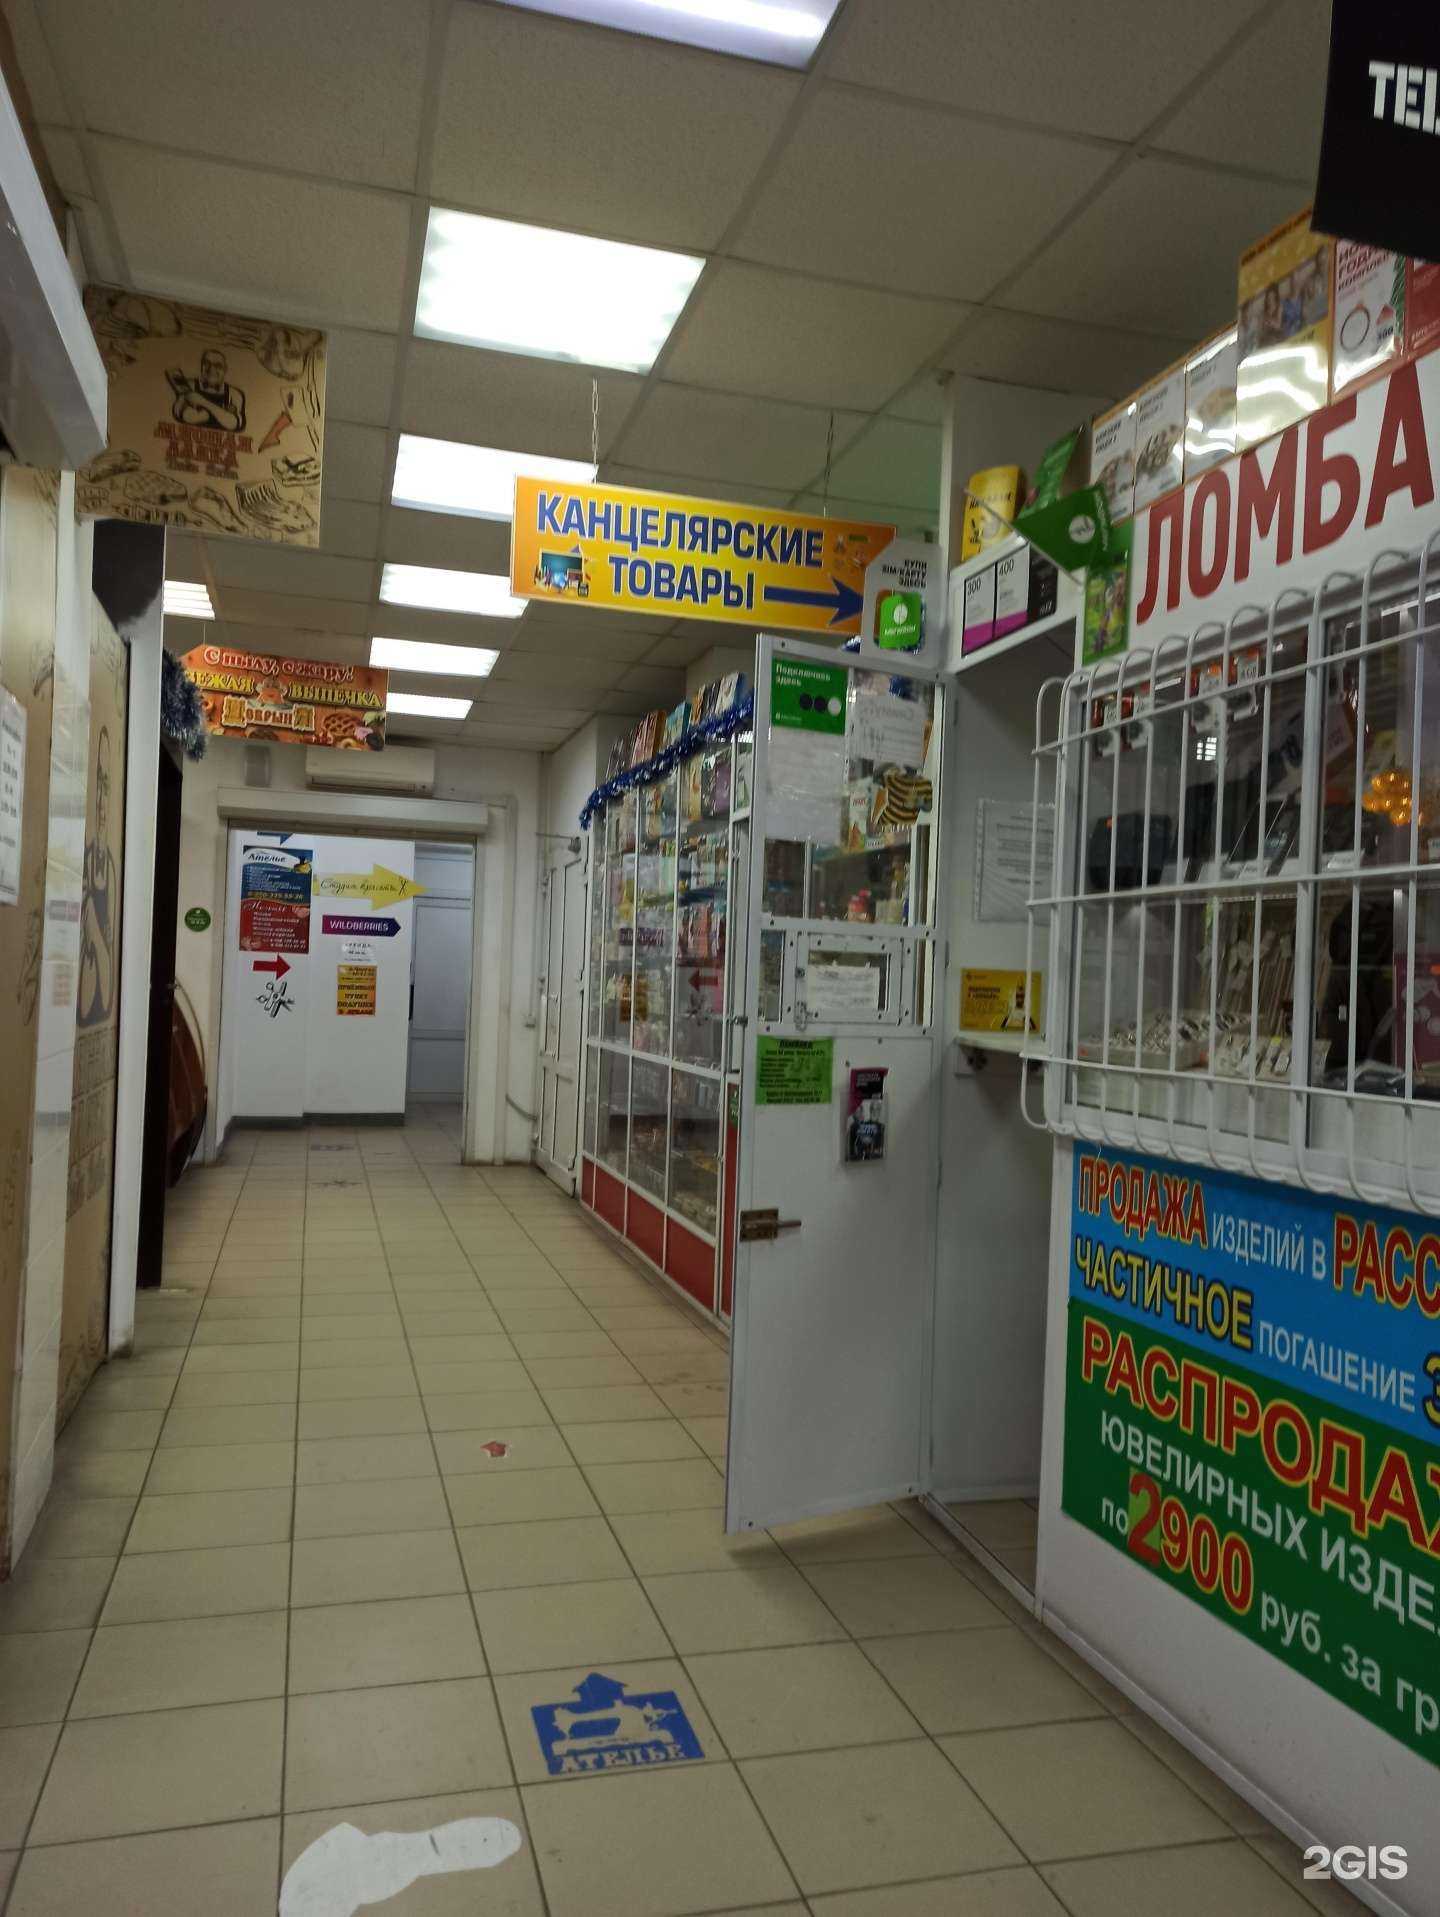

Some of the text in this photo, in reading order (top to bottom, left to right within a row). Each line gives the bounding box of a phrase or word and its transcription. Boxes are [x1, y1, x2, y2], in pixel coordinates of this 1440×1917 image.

[536, 491, 825, 568] КАНЦЕЛЯРСКИЕ
[1136, 357, 1435, 626] ЛОМБА
[608, 553, 755, 610] ТОВАРЫ
[184, 671, 384, 709] ВЕЖАЯ ВЫПЕЧКА
[329, 919, 389, 932] WILDBERRIES
[1078, 1154, 1208, 1250] ПРОДАЖА
[1212, 1212, 1304, 1276] ИЗДЕЛИЙ
[1311, 1237, 1327, 1281] В
[1074, 1235, 1254, 1352] ЧАСТИЧНОЕ
[1258, 1320, 1416, 1414] ПОГАШЕНИЕ
[1101, 1410, 1440, 1638] ЮВЕЛИРНЫХ ИЗДЕ
[1127, 1470, 1254, 1617] 2900
[1260, 1590, 1332, 1664] руб.
[1340, 1643, 1382, 1696] за
[561, 1743, 688, 1774] АТЕЛЬЕ
